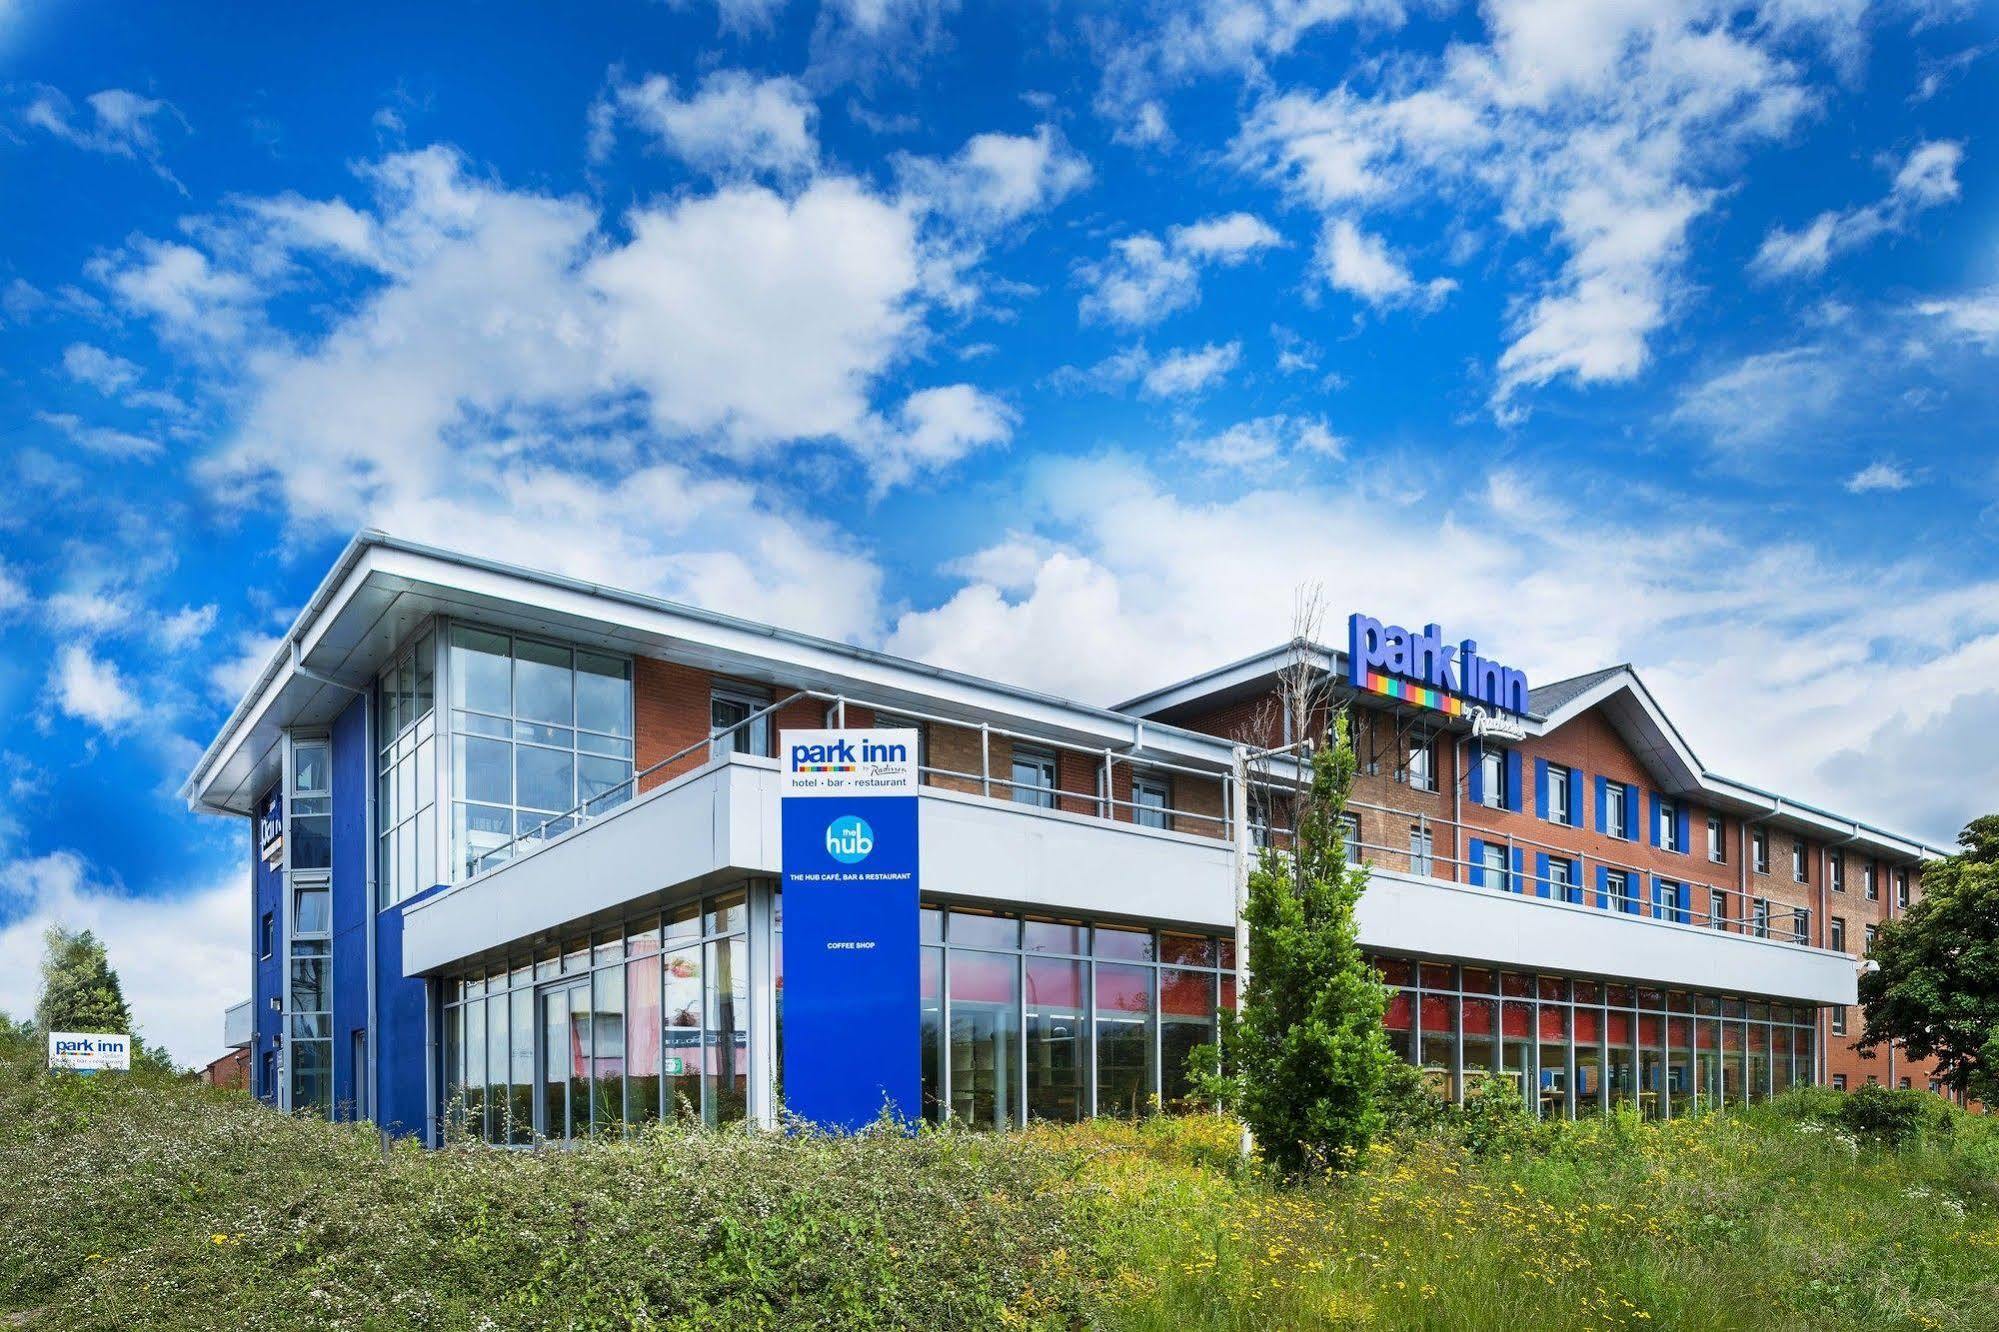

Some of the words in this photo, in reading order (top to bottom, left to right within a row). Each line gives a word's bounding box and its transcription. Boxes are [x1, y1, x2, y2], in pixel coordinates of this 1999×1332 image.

[1348, 613, 1458, 692] park
[1460, 639, 1529, 716] inn
[792, 739, 856, 772] park
[862, 739, 906, 762] inn
[792, 779, 817, 787] hotel
[827, 779, 844, 787] bar
[855, 778, 907, 787] restaurant
[826, 823, 873, 854] hub
[843, 829, 857, 837] the
[843, 873, 857, 881] BAR
[865, 872, 912, 881] RESTAURANT
[827, 942, 855, 950] COFFEE
[56, 1039, 94, 1056] park
[98, 1040, 124, 1052] inn
